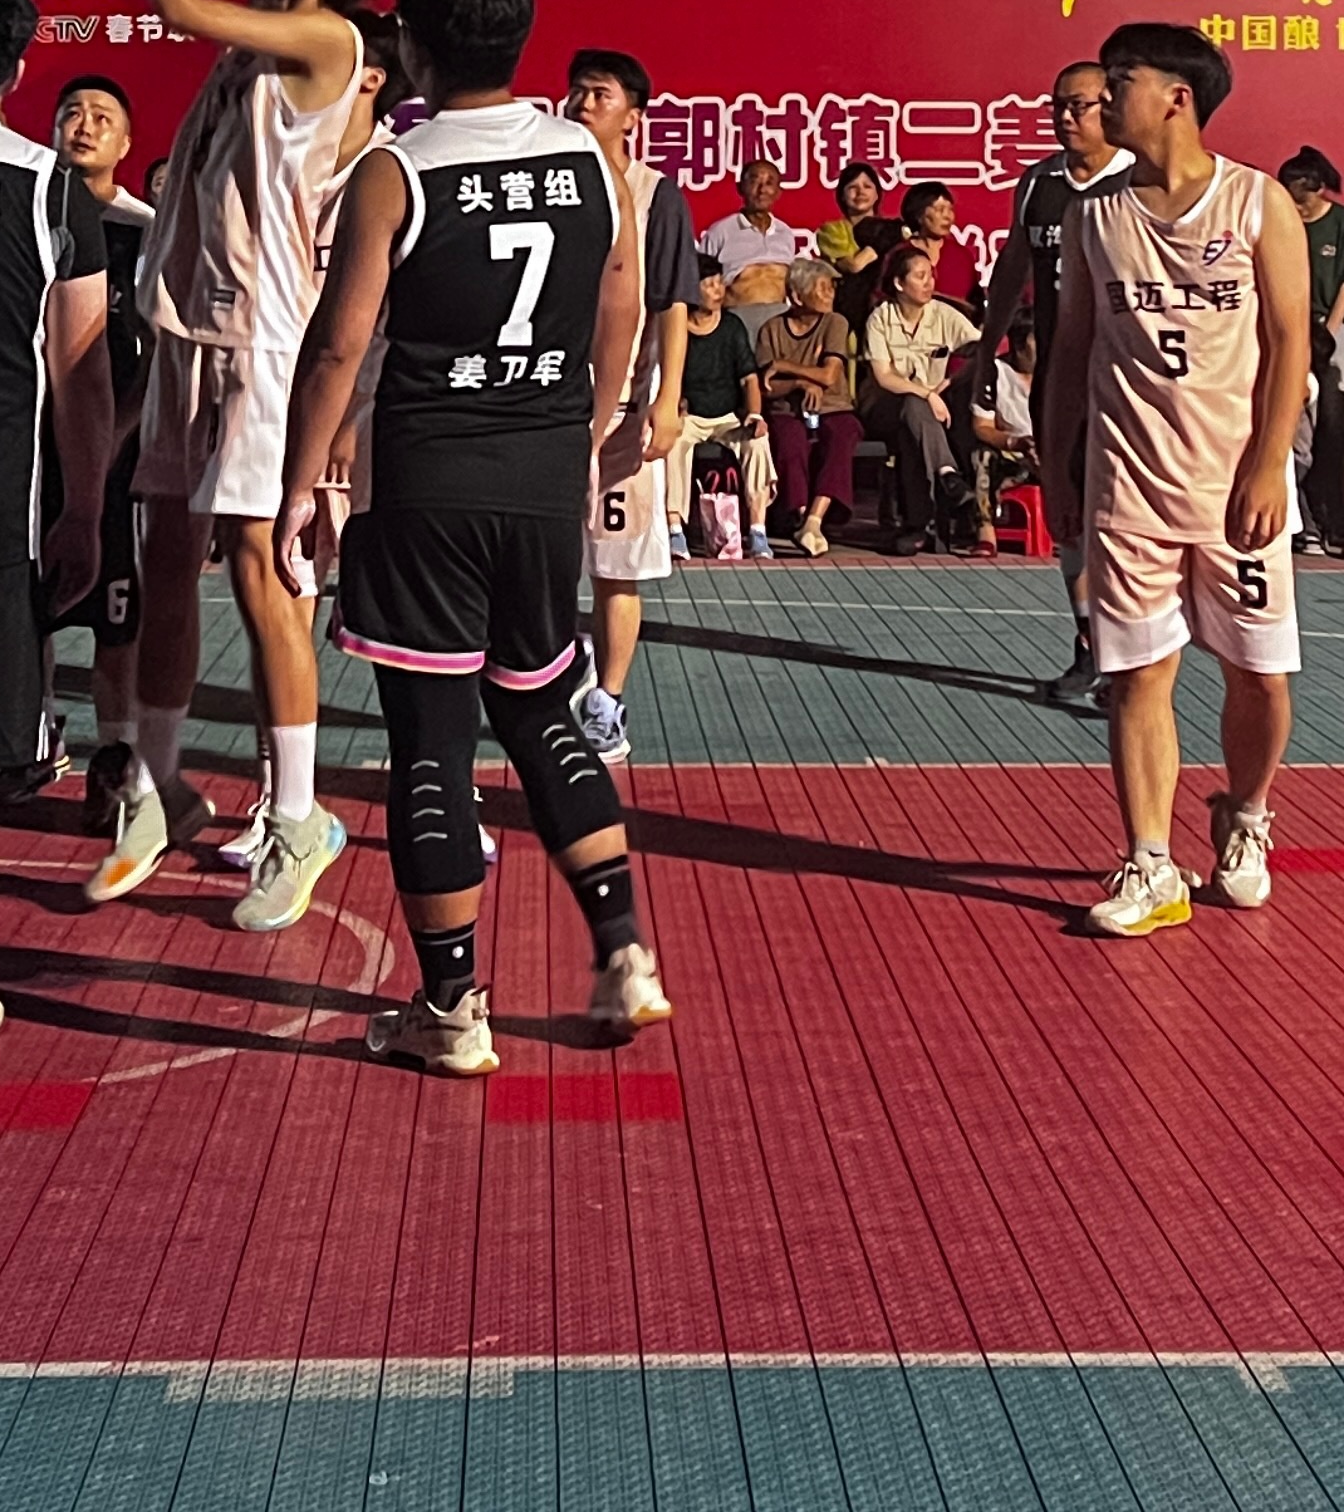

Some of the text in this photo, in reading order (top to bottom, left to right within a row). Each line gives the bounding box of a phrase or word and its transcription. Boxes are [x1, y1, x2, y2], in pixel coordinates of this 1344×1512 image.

[1200, 13, 1320, 51] 中国酿
[456, 168, 583, 215] 头营组
[488, 221, 555, 347] 7
[448, 350, 566, 389] 姜卫军
[1158, 329, 1189, 380] 5
[603, 491, 626, 532] 6
[108, 578, 130, 624] 6
[1236, 559, 1268, 610] 5
